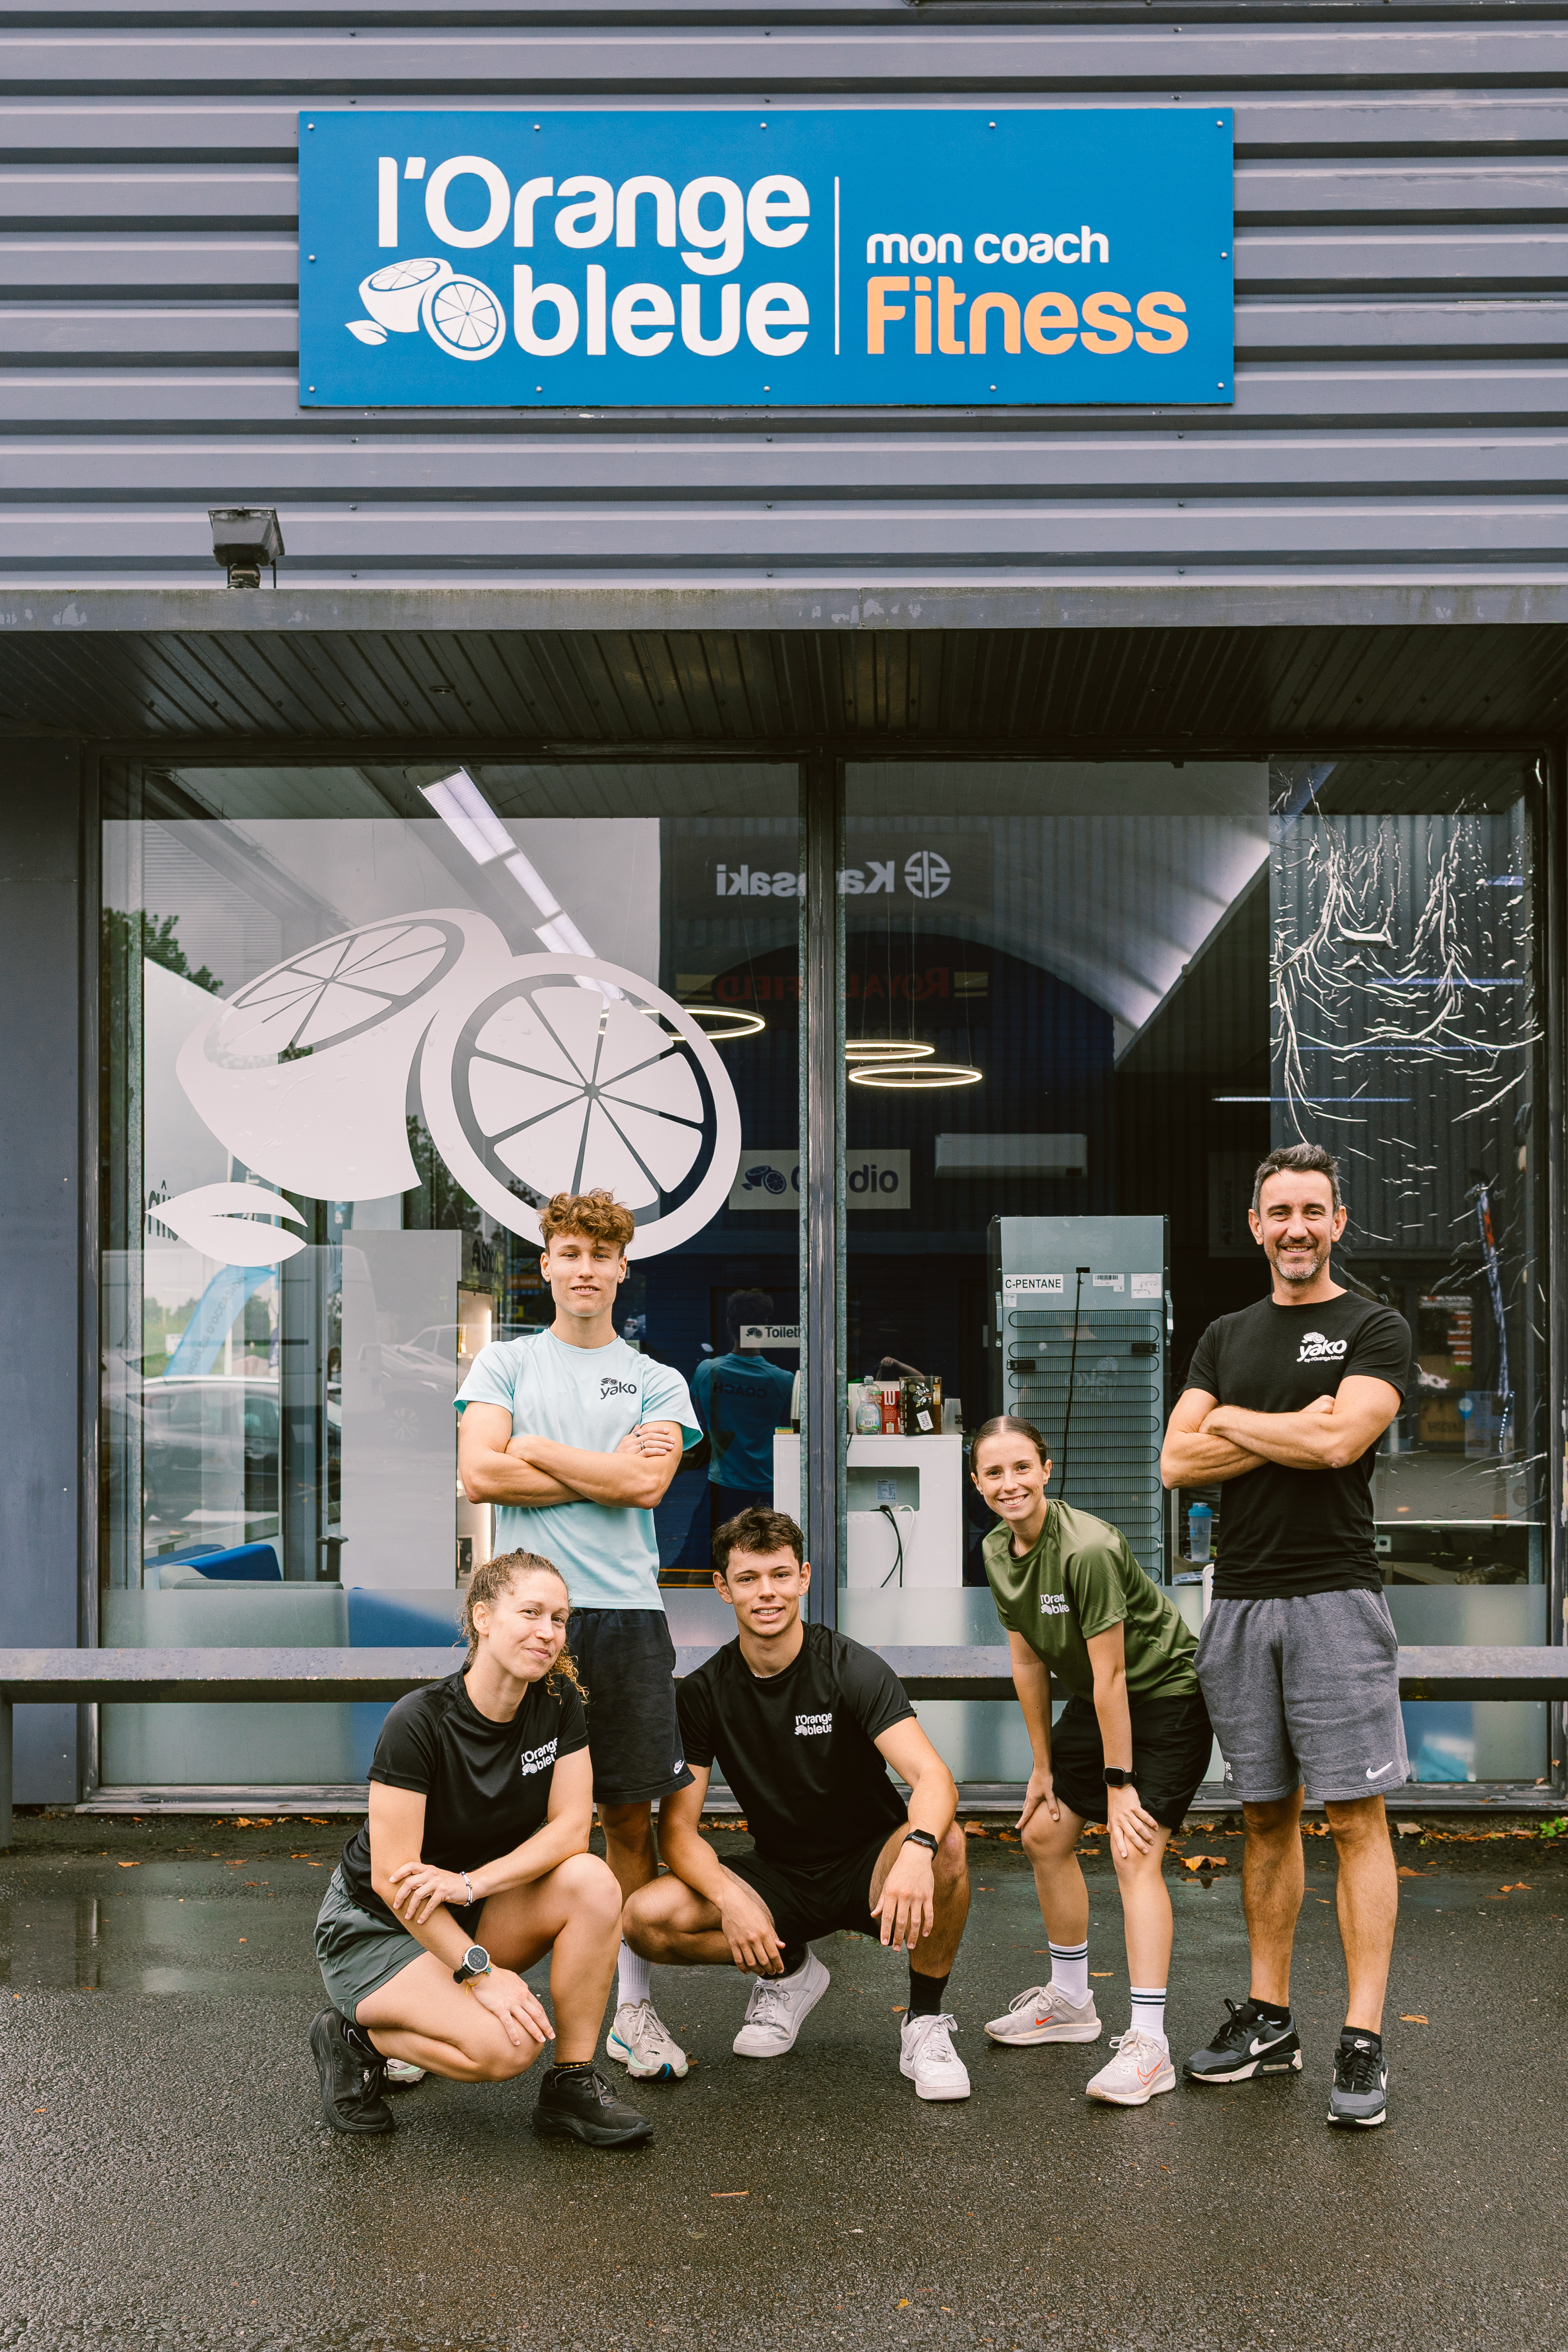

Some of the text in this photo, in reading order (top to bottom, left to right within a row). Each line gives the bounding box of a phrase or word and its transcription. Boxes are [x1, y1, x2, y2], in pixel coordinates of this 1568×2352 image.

[378, 155, 810, 276] l'Orange
[867, 225, 1109, 264] mon coach
[513, 264, 810, 357] bleue
[867, 276, 1188, 355] Fitness
[1005, 1279, 1062, 1289] C-PENTANE
[1296, 1339, 1347, 1362] yako
[600, 1382, 637, 1400] yako
[884, 1390, 895, 1406] LU
[796, 1712, 832, 1726] l'Orange
[807, 1724, 832, 1735] bleue
